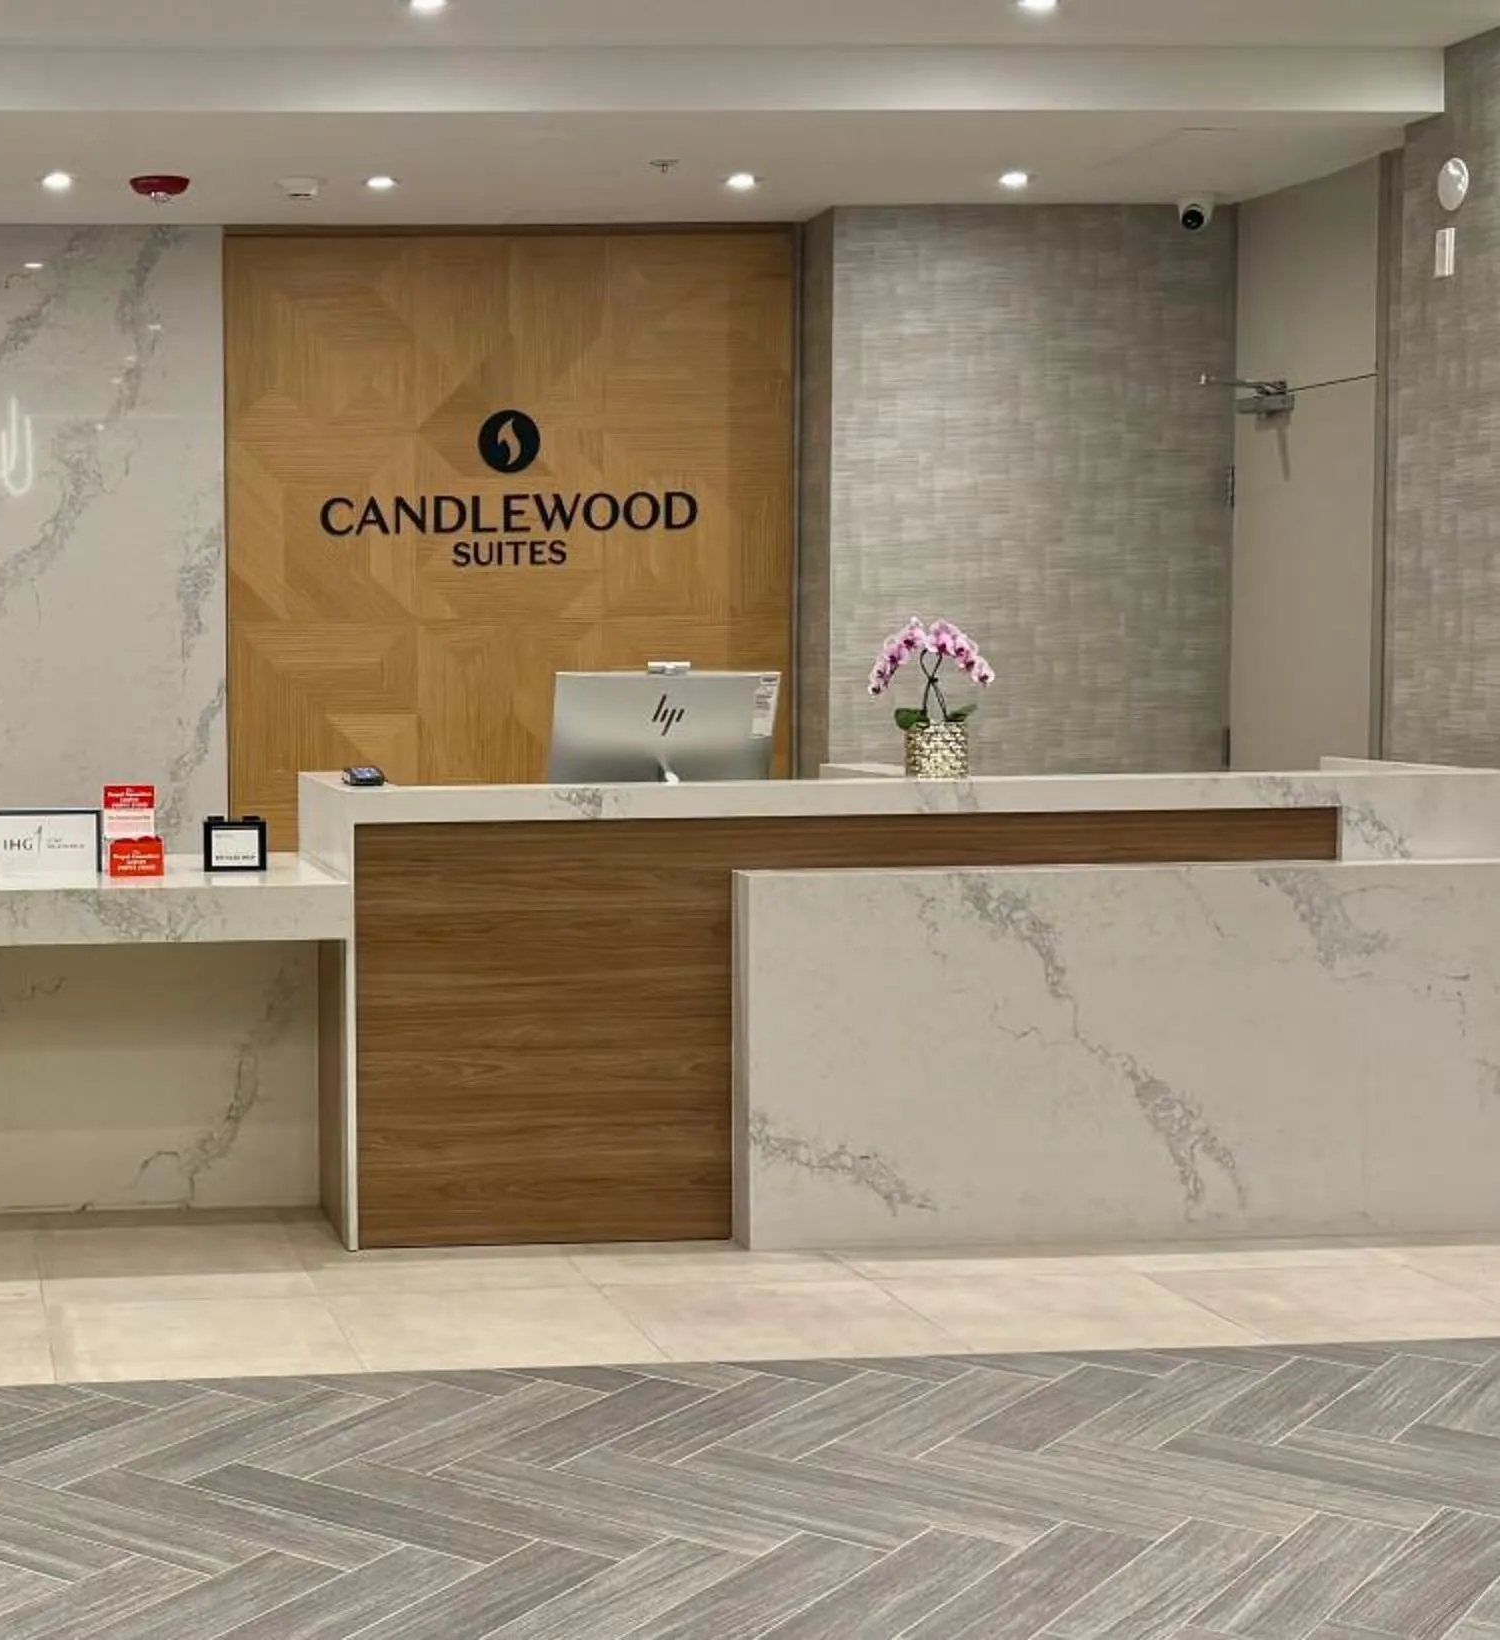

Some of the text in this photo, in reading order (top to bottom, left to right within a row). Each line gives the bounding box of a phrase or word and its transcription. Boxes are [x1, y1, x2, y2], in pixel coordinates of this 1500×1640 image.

[319, 491, 698, 536] CANDLEWOOD
[452, 540, 567, 567] SUITES
[3, 839, 33, 850] IHG
